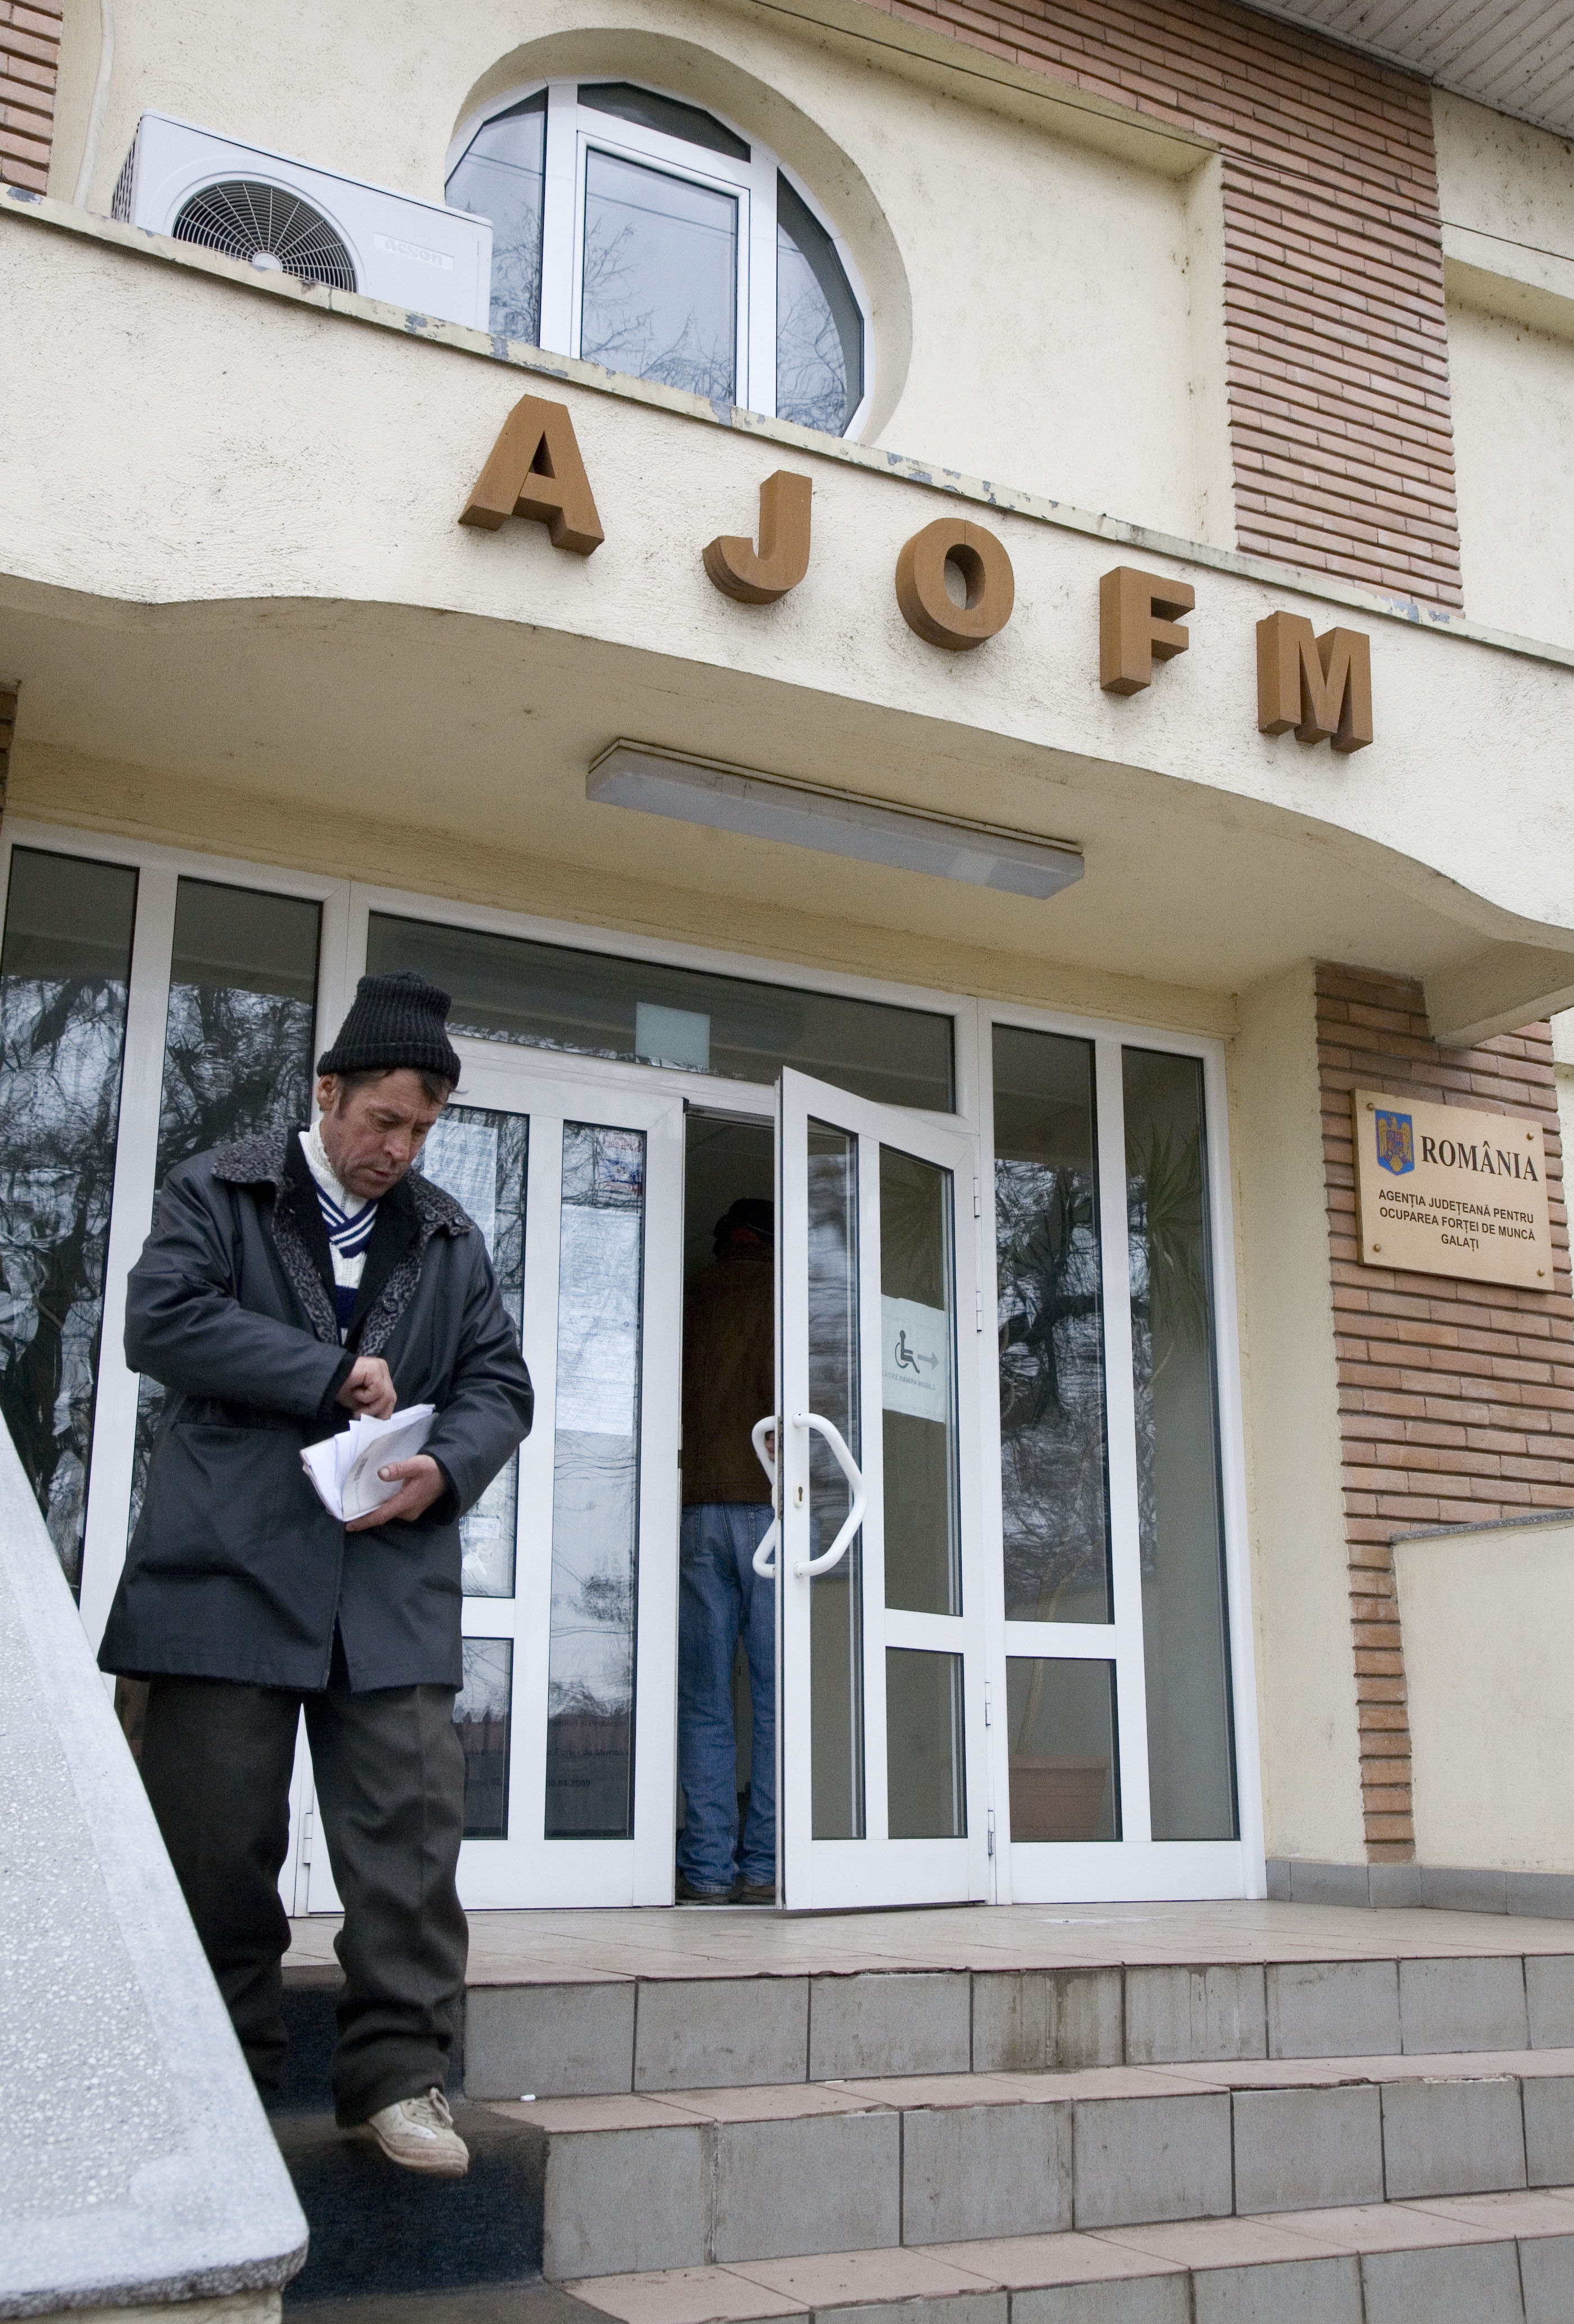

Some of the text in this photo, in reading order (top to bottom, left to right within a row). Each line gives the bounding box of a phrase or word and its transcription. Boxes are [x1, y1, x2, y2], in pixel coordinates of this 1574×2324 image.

[458, 393, 1374, 754] AJOFM
[1420, 1136, 1539, 1181] ROMÂNIA
[1379, 1189, 1534, 1224] AGENȚIA JUDEȚEANĂ PENTRU
[1380, 1207, 1535, 1241] OCUPAREA FORȚEI DE MUNCĂ
[1441, 1234, 1479, 1252] GALAȚI
